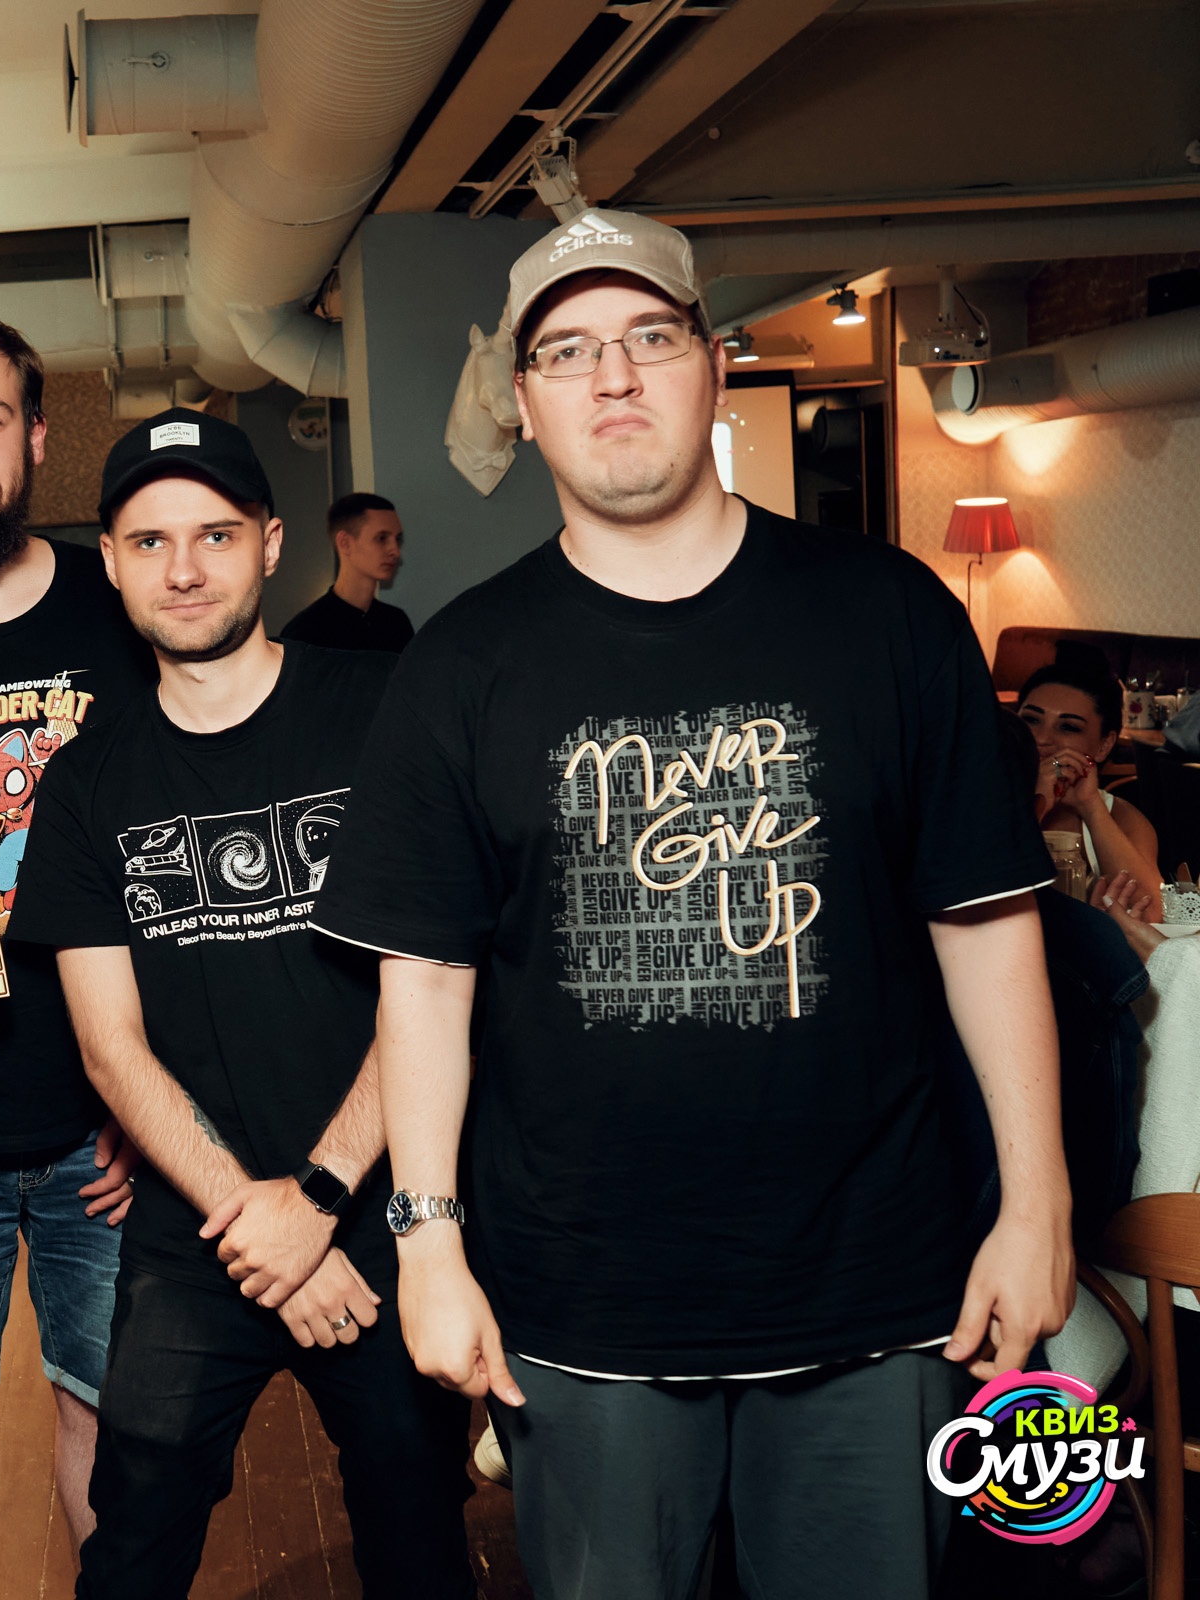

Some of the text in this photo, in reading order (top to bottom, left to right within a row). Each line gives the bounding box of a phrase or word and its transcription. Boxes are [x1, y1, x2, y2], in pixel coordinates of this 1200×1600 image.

[549, 232, 633, 263] adidas
[650, 737, 673, 748] EVER
[577, 758, 613, 772] NEVR
[618, 755, 641, 770] GIVE
[577, 773, 592, 810] NEVER
[698, 790, 729, 803] NEVER
[733, 788, 755, 800] GIVE
[629, 795, 650, 807] GIV
[780, 801, 807, 817] GIVE
[569, 816, 595, 831] GIVE
[579, 855, 617, 869] GIVE UP
[582, 872, 619, 888] NEVER
[624, 871, 643, 886] GIV
[599, 887, 671, 911] GIVE UP
[687, 885, 703, 921] NEVER
[703, 882, 746, 907] GVE
[582, 889, 598, 925] NEVER
[740, 906, 763, 918] GIVE
[143, 915, 198, 939] UNLEAS
[199, 914, 239, 926] YOUR
[243, 907, 280, 925] INNER
[600, 911, 672, 925] NEVER GIVE UP
[177, 934, 199, 946] Disco
[200, 932, 215, 940] the
[216, 931, 246, 941] Beauty
[276, 922, 306, 934] Earth's
[576, 930, 621, 946] GIVE UP
[636, 929, 674, 944] NEVER
[678, 927, 705, 943] GIVE
[598, 946, 622, 969] UP
[637, 945, 651, 982] NEVER
[653, 945, 695, 967] GIVE
[702, 945, 727, 967] UP
[585, 971, 607, 982] GIVE
[610, 970, 623, 982] UP
[653, 967, 728, 981] NEVER GIVE UP
[761, 965, 786, 978] NEVE
[588, 988, 674, 1003] NEVER GIVE UP
[691, 987, 730, 1002] NEVER
[735, 985, 763, 1000] GIVE
[767, 984, 783, 1000] UP
